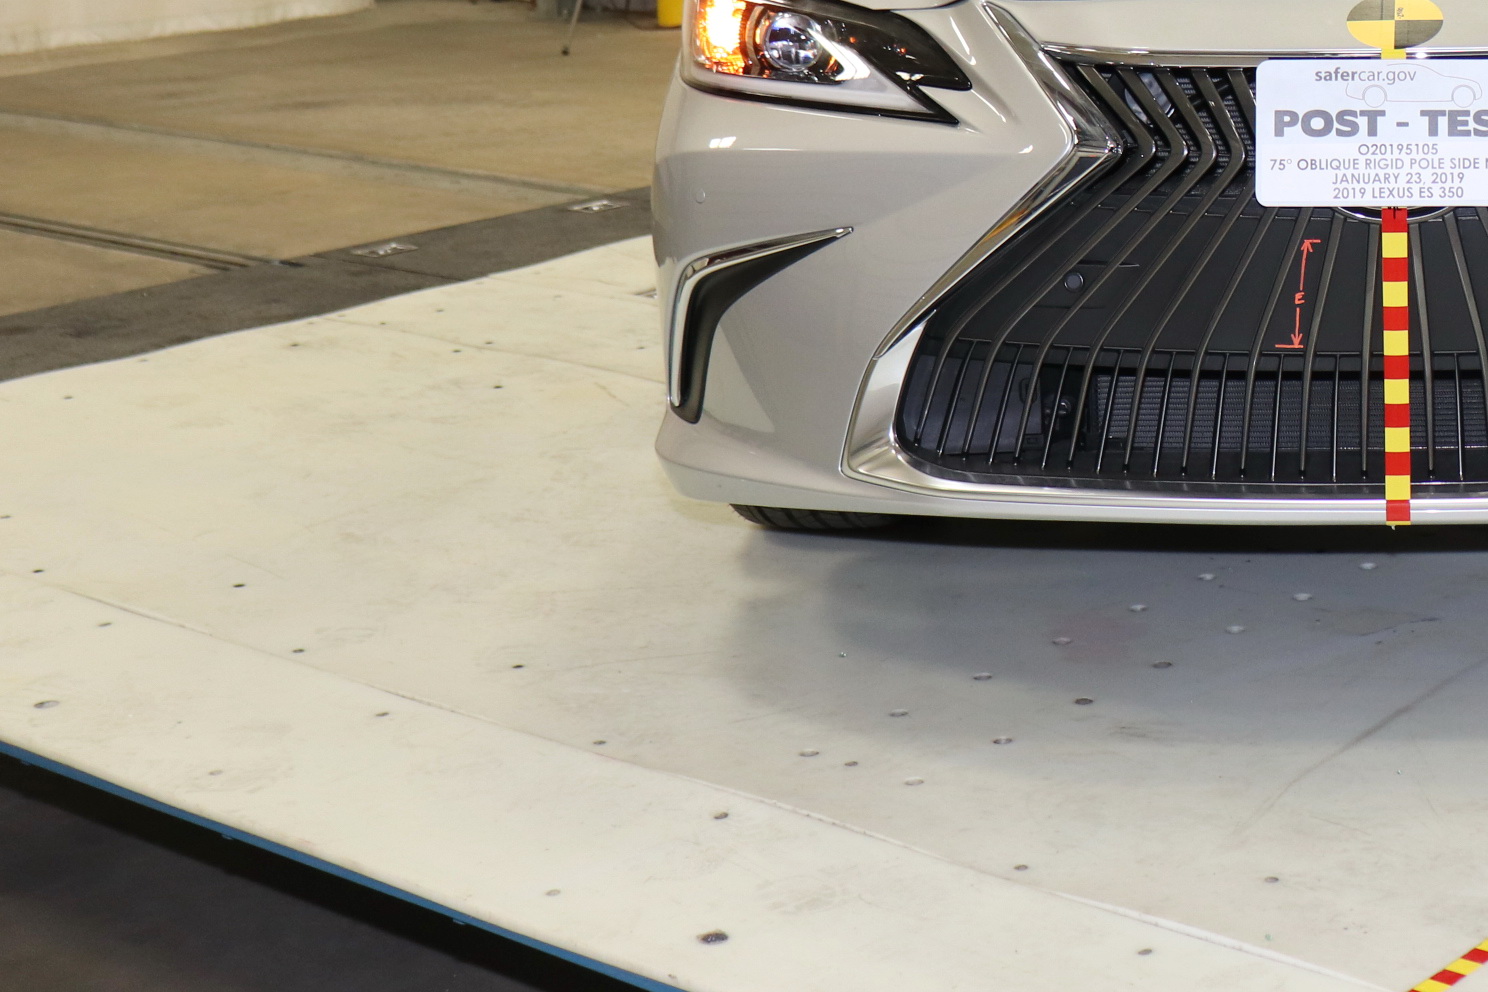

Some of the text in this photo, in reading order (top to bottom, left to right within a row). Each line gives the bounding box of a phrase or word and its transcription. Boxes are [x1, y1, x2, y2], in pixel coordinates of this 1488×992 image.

[1315, 66, 1417, 85] safercar.gov
[1274, 110, 1386, 137] POST
[1297, 159, 1360, 171] OBLIQUE
[1365, 158, 1405, 170] RIGID
[1410, 158, 1445, 170] POLE
[1449, 158, 1481, 169] SIDE
[1332, 172, 1465, 186] JANUARY 23, 2019
[1333, 186, 1464, 199] 2019 LEXUS ES 350
[1294, 292, 1305, 305] E
